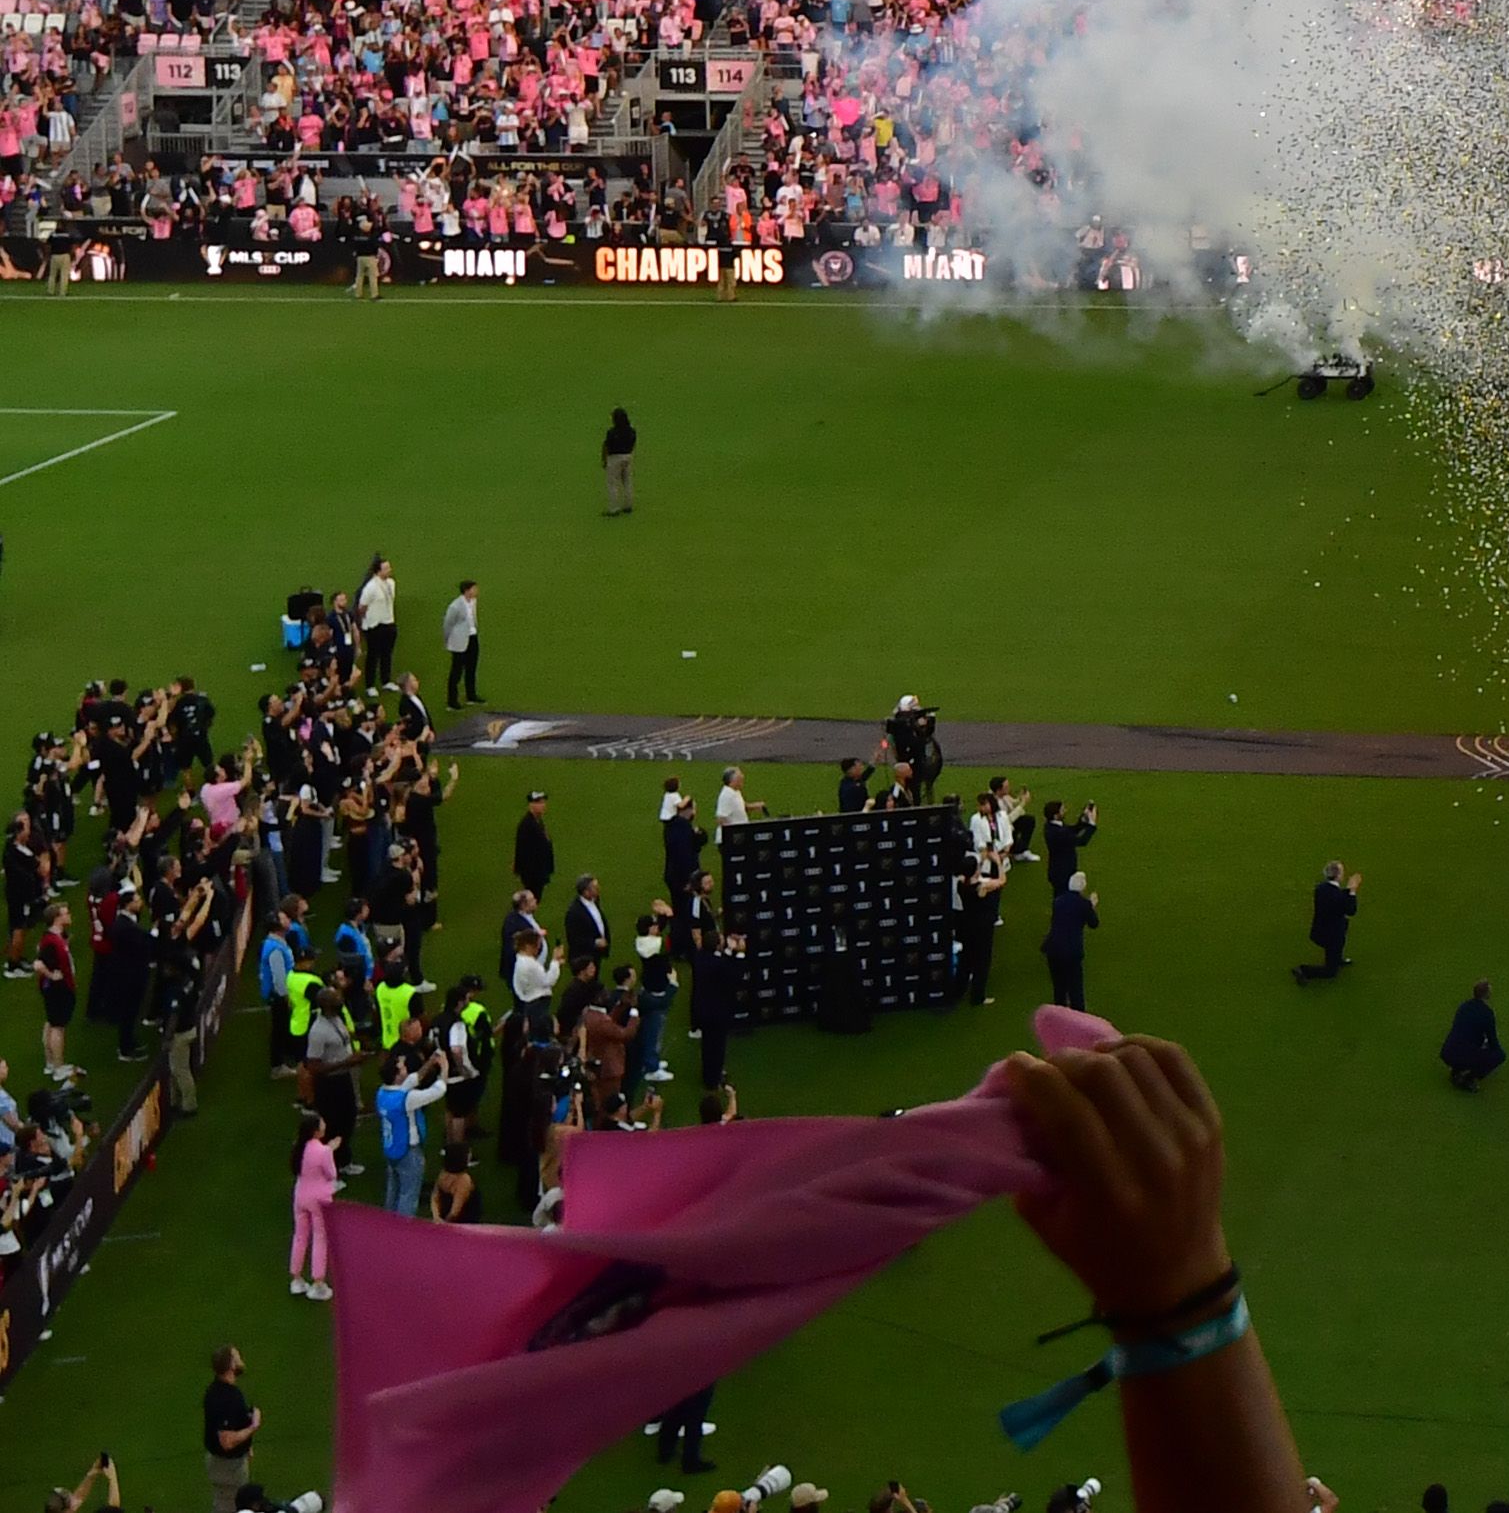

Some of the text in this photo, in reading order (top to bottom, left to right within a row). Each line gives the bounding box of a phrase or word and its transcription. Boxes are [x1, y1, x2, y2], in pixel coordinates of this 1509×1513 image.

[168, 64, 193, 78] 112
[214, 63, 241, 80] 113
[669, 67, 697, 84] 113
[718, 69, 743, 83] 114
[229, 251, 310, 264] MLS CUP
[444, 249, 526, 277] MIAMI
[595, 247, 784, 283] CHAMPINS
